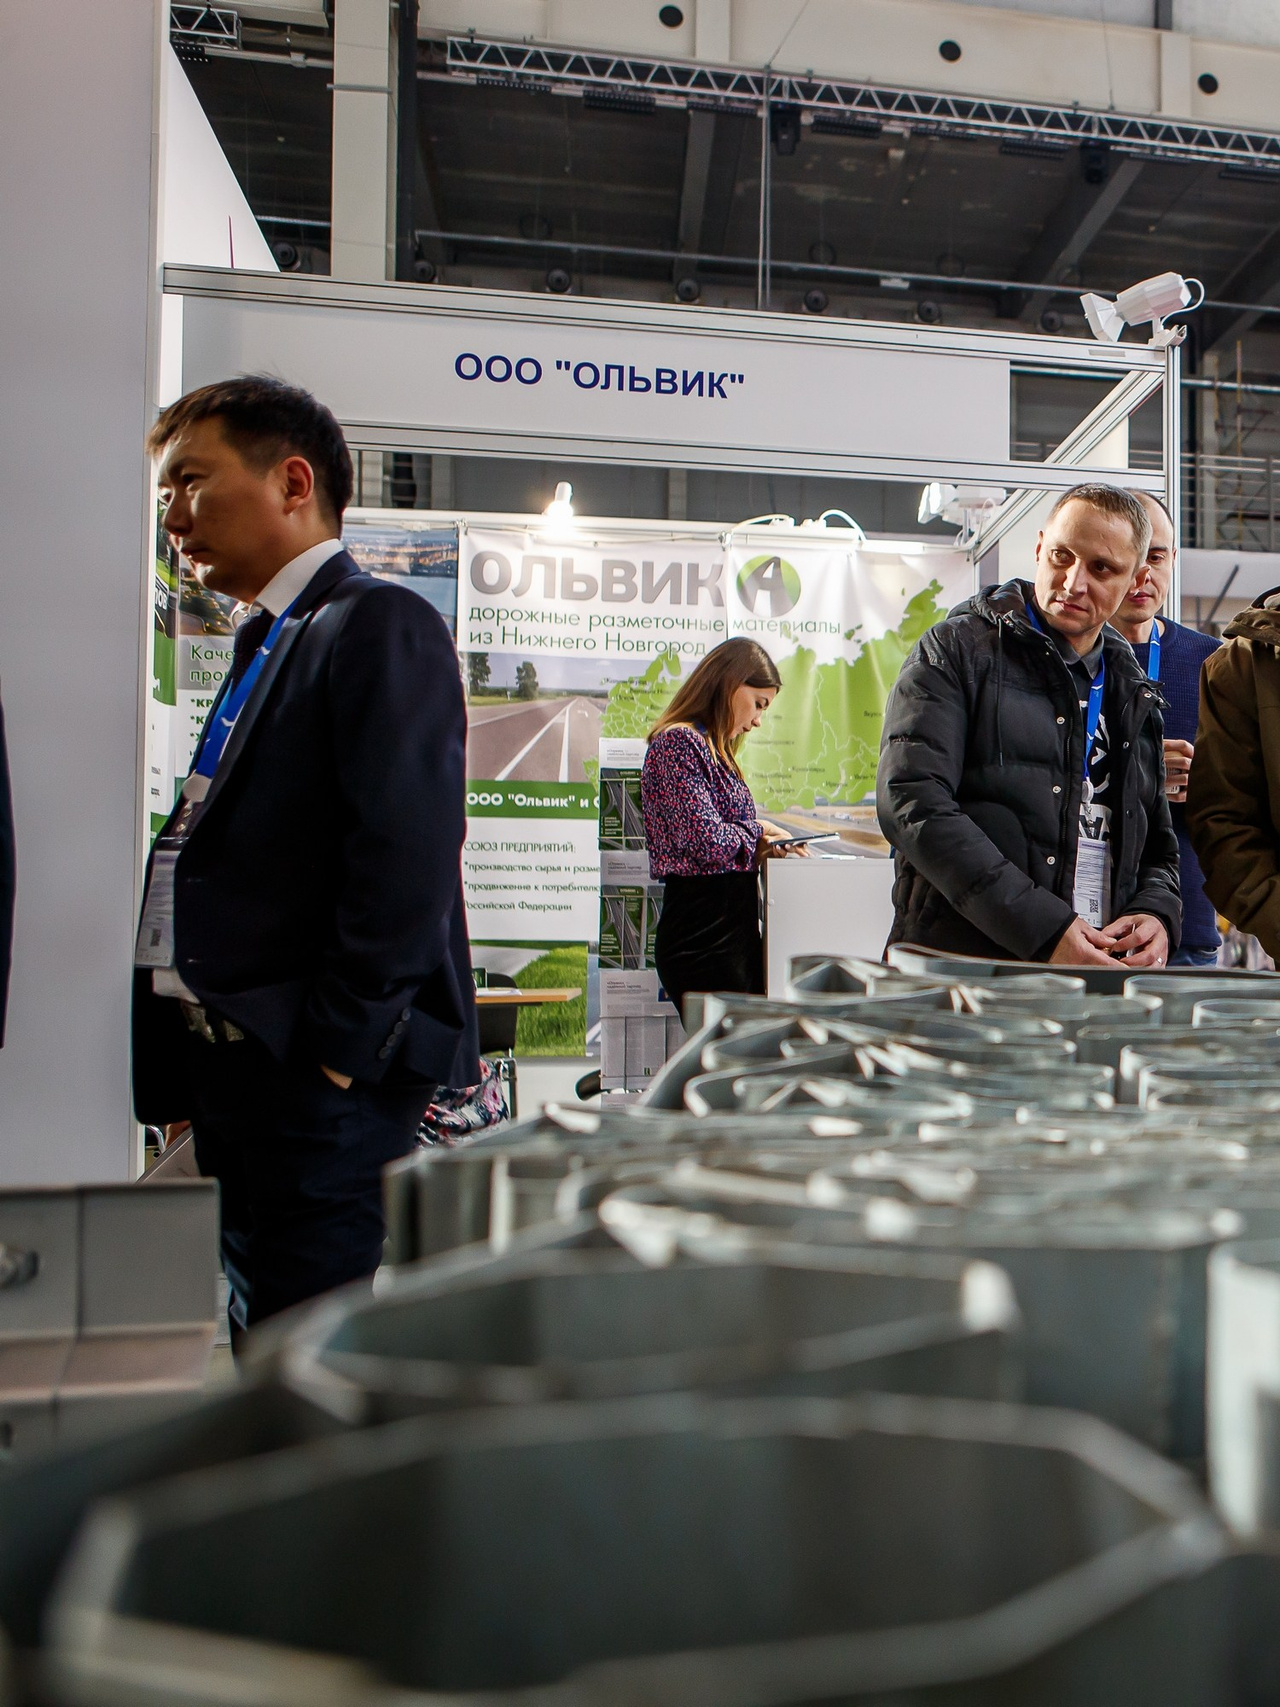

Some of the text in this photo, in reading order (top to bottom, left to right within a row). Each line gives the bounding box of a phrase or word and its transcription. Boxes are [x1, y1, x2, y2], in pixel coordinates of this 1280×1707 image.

[454, 352, 745, 399] ООО "ОЛЬВИК"
[468, 606, 841, 638] дорожные разметочные материалы
[469, 633, 493, 645] из
[501, 626, 597, 651] Нижнего
[466, 792, 504, 807] ООО
[508, 793, 576, 808] "Ольвик"
[579, 798, 589, 808] и
[464, 841, 576, 854] СОЮЗ ПРЕДПРИЯТИЙ:
[535, 864, 562, 874] сырья
[518, 901, 572, 912] Федерации
